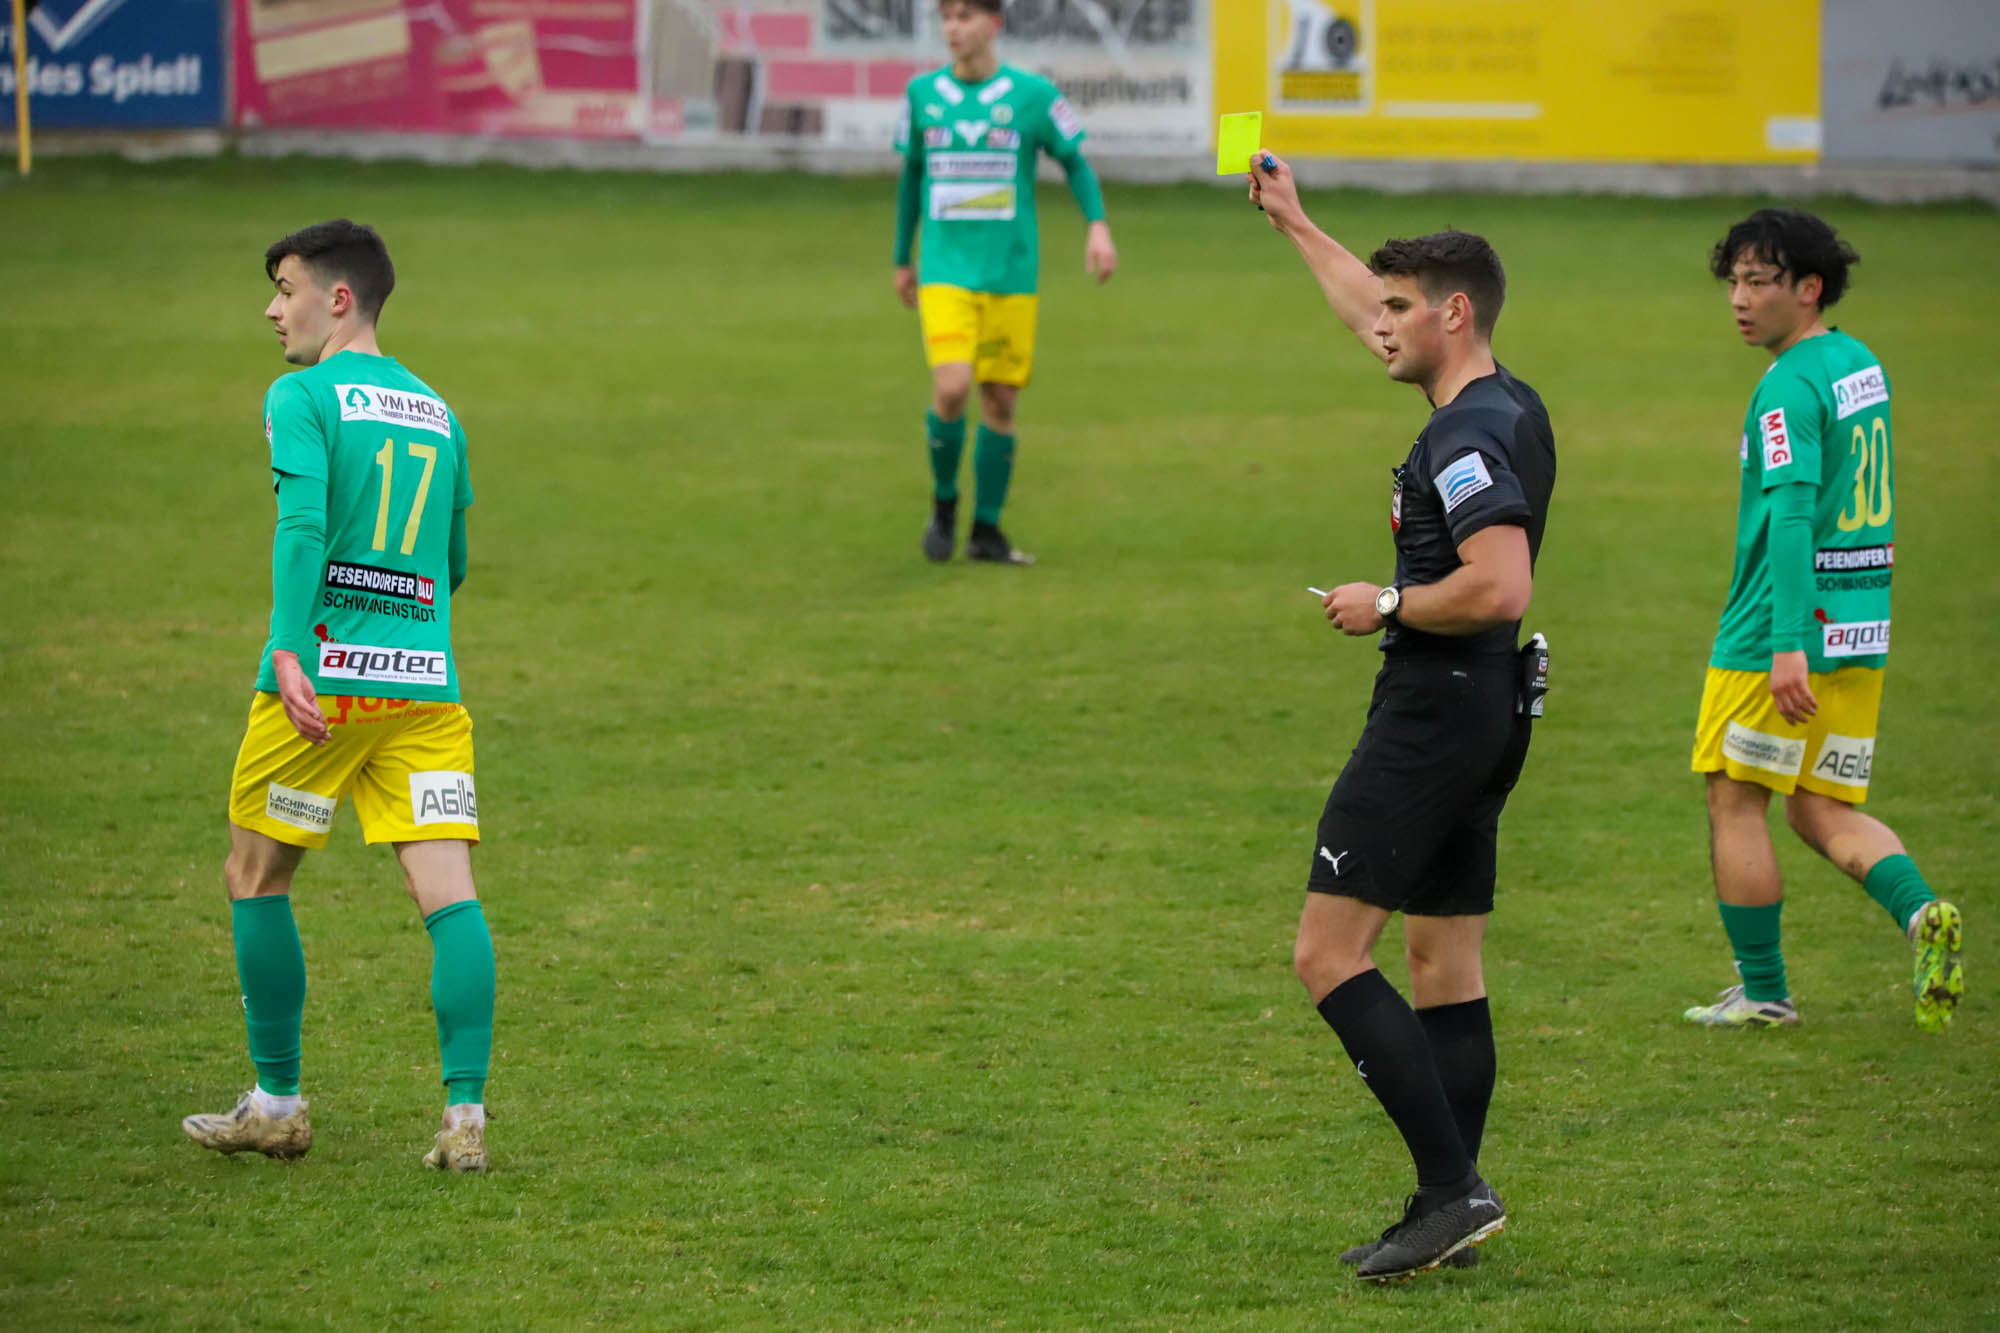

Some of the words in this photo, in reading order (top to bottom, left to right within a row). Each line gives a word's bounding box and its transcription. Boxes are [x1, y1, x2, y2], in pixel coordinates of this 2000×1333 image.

[89, 53, 202, 104] Spiel!
[376, 392, 404, 411] VM
[407, 399, 449, 424] HOLZ
[1767, 412, 1788, 465] MPG
[1837, 417, 1892, 532] 30
[372, 438, 437, 555] 17
[327, 564, 416, 596] PESENDORFER
[323, 591, 437, 623] SCHWANENSTADT
[323, 650, 445, 676] aqotec
[269, 792, 330, 818] LACHINGER
